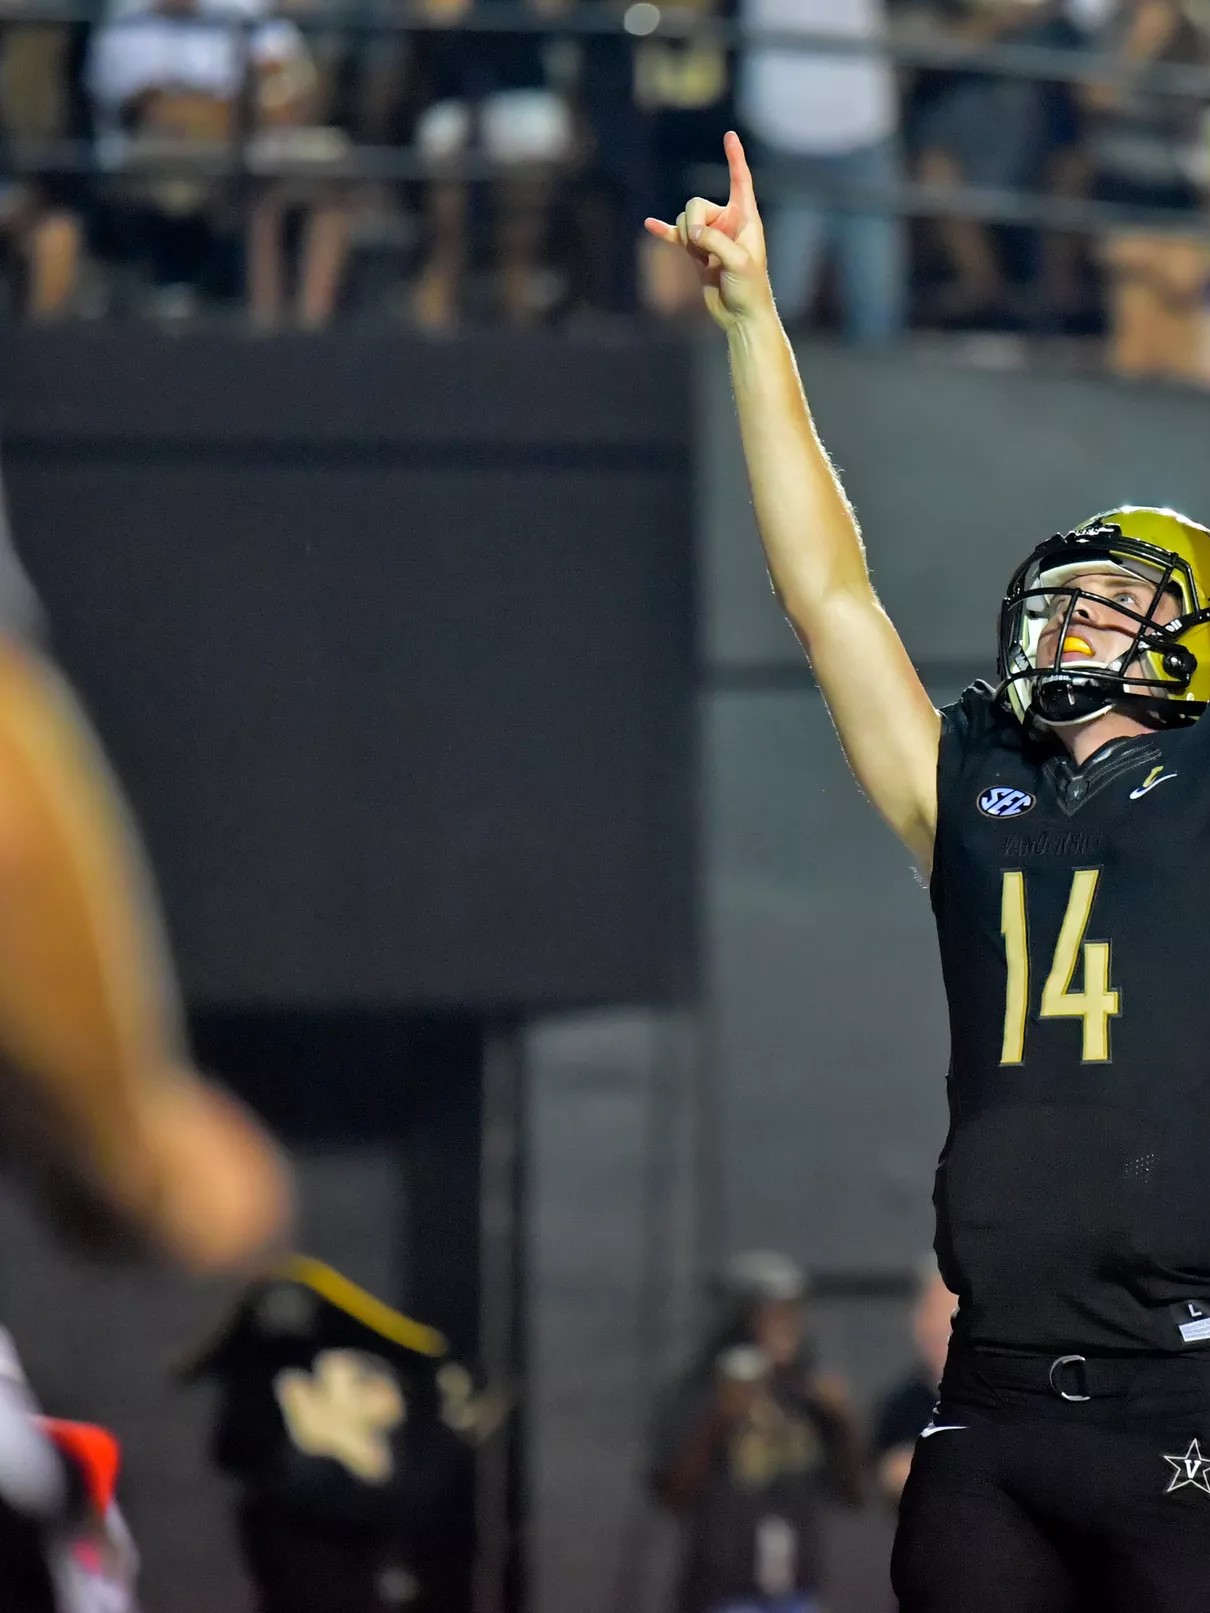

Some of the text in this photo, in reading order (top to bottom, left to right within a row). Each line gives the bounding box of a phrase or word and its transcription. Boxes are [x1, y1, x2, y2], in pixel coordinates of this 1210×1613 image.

[979, 786, 1034, 817] SEC
[1001, 868, 1119, 1064] 14
[1188, 1304, 1202, 1317] L
[1184, 1459, 1202, 1479] V
